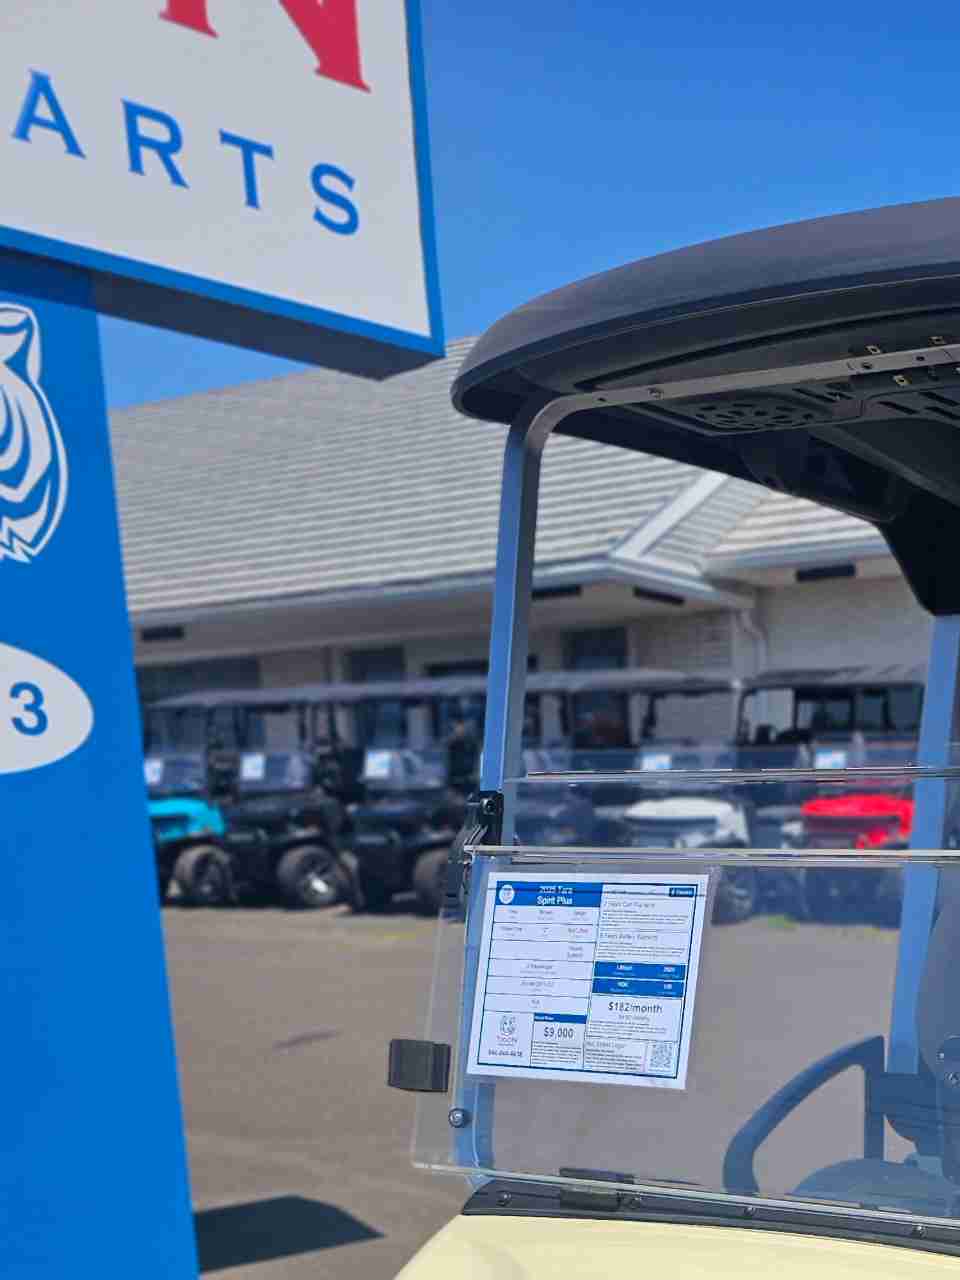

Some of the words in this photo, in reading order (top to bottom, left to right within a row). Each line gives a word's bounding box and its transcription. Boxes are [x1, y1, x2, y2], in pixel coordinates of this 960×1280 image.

[536, 895, 555, 906] Spirit
[556, 896, 573, 905] Plus
[544, 1027, 574, 1039] $9,000
